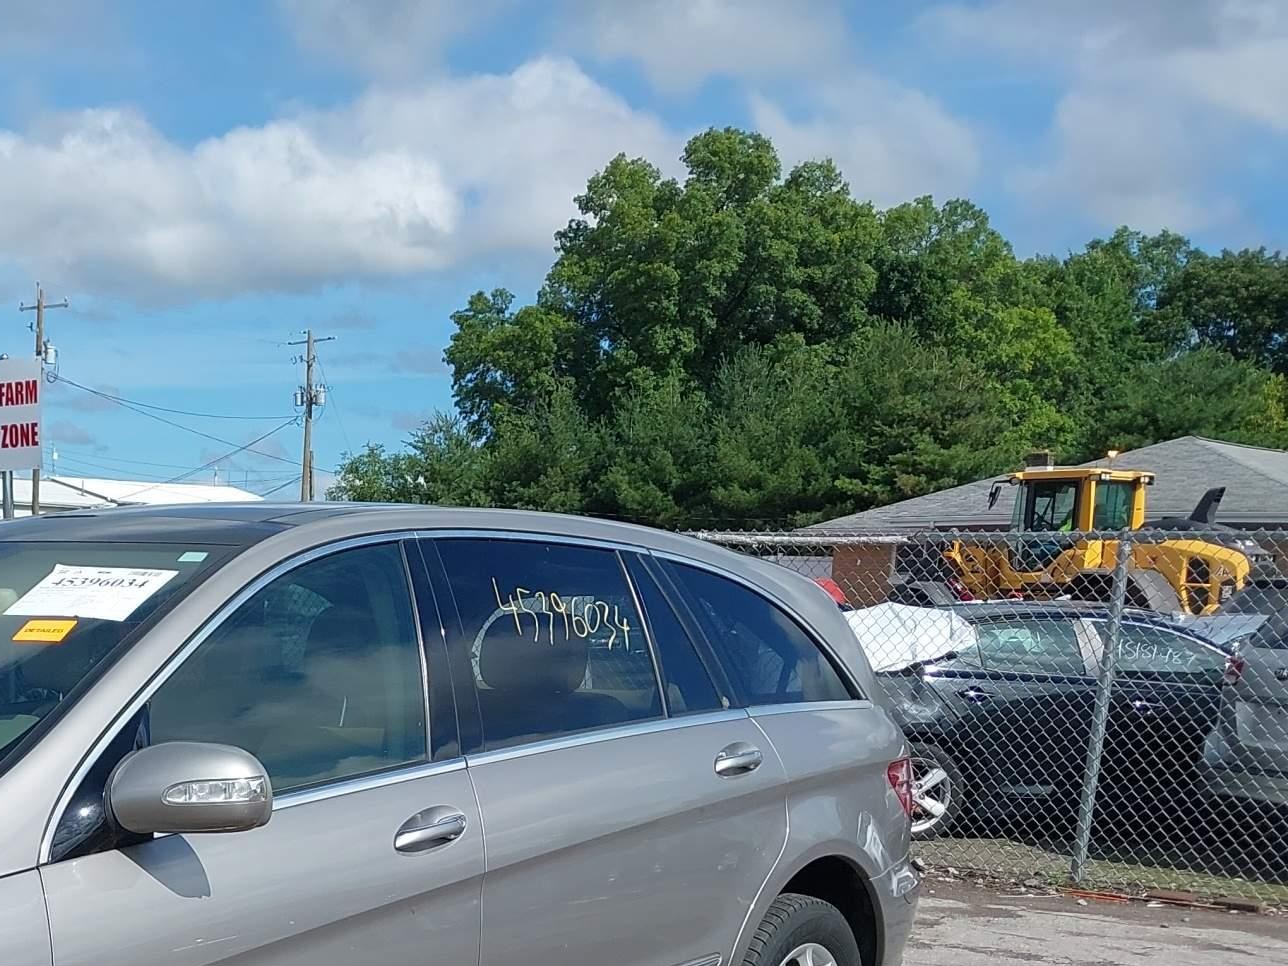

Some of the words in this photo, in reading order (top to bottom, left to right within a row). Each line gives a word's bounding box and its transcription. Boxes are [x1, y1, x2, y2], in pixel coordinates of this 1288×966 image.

[0, 379, 38, 407] FARM
[1, 422, 39, 449] ZONE
[51, 577, 149, 589] 45396034
